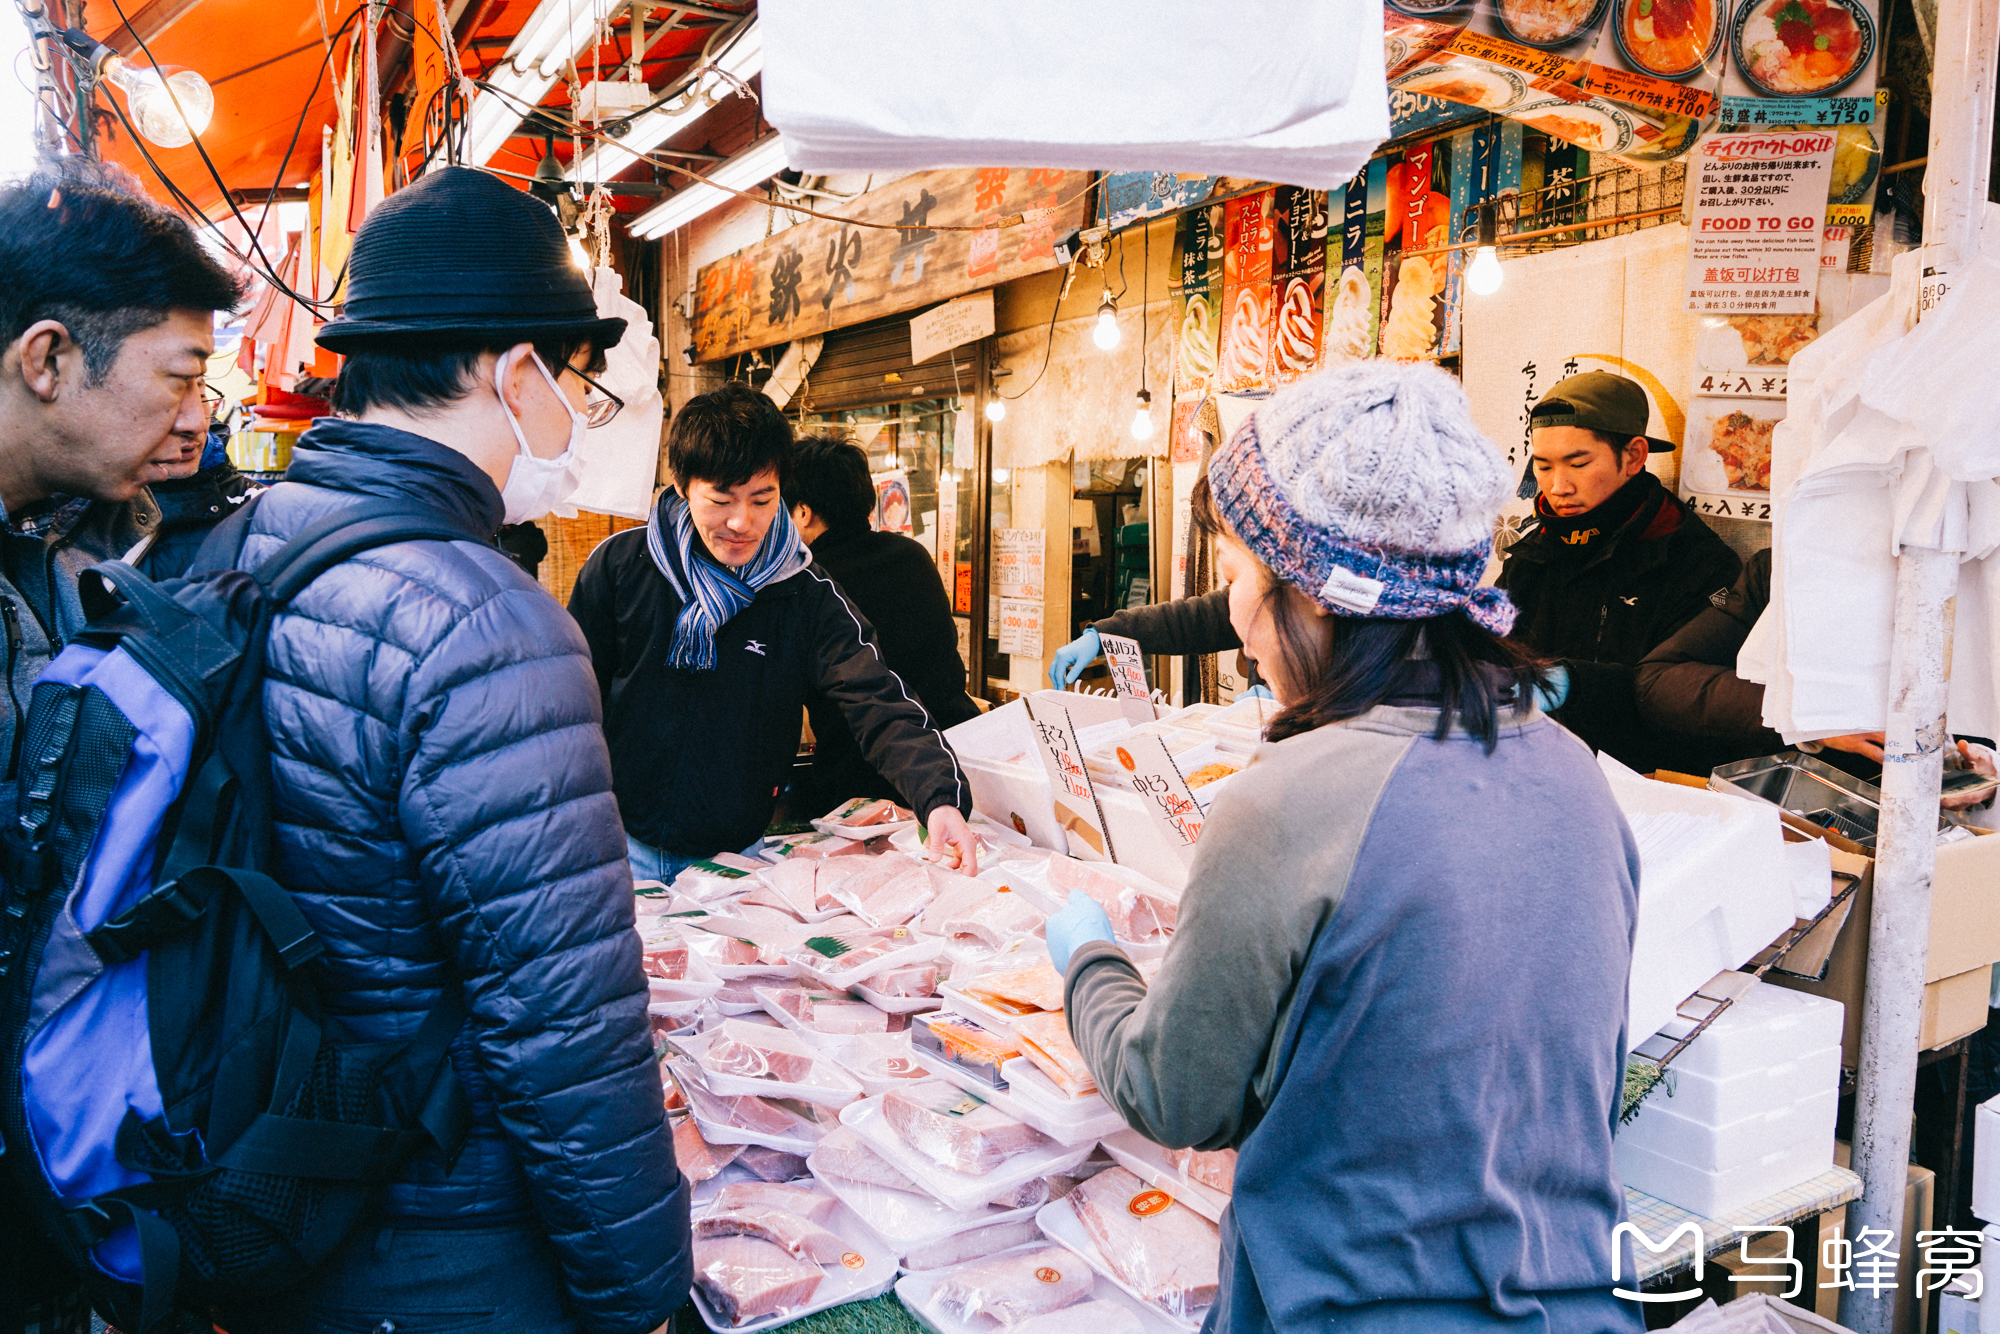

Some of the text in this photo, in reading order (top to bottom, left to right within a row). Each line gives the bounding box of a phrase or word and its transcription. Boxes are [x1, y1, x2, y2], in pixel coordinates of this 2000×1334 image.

[1525, 60, 1566, 80] ¥650
[1585, 78, 1663, 106] サーモン・イクラ丼
[1665, 97, 1704, 117] ¥700
[1678, 88, 1699, 103] ¥400
[1829, 102, 1858, 111] ¥450
[1722, 108, 1767, 124] 特盛丼
[1817, 110, 1870, 124] ¥750
[1707, 138, 1830, 156] テイクアウトOK!!
[1703, 160, 1821, 171] どんぶりのお持ち帰り出来ます。
[1702, 173, 1794, 183] 但し、生鮮食品ですので、
[1407, 151, 1428, 243] マンゴー
[1700, 185, 1789, 195] ご購入後、30分以内に
[1346, 168, 1366, 250] バニラ
[1699, 197, 1774, 207] お召し上がり下さい。
[1290, 190, 1301, 270] チョコレート
[1701, 216, 1814, 231] FOOD TO GO
[1238, 205, 1250, 282] ストロベリー
[1184, 252, 1196, 286] 抹茶
[1703, 267, 1800, 282] 盖饭可以打包
[1036, 720, 1068, 751] まぐろ
